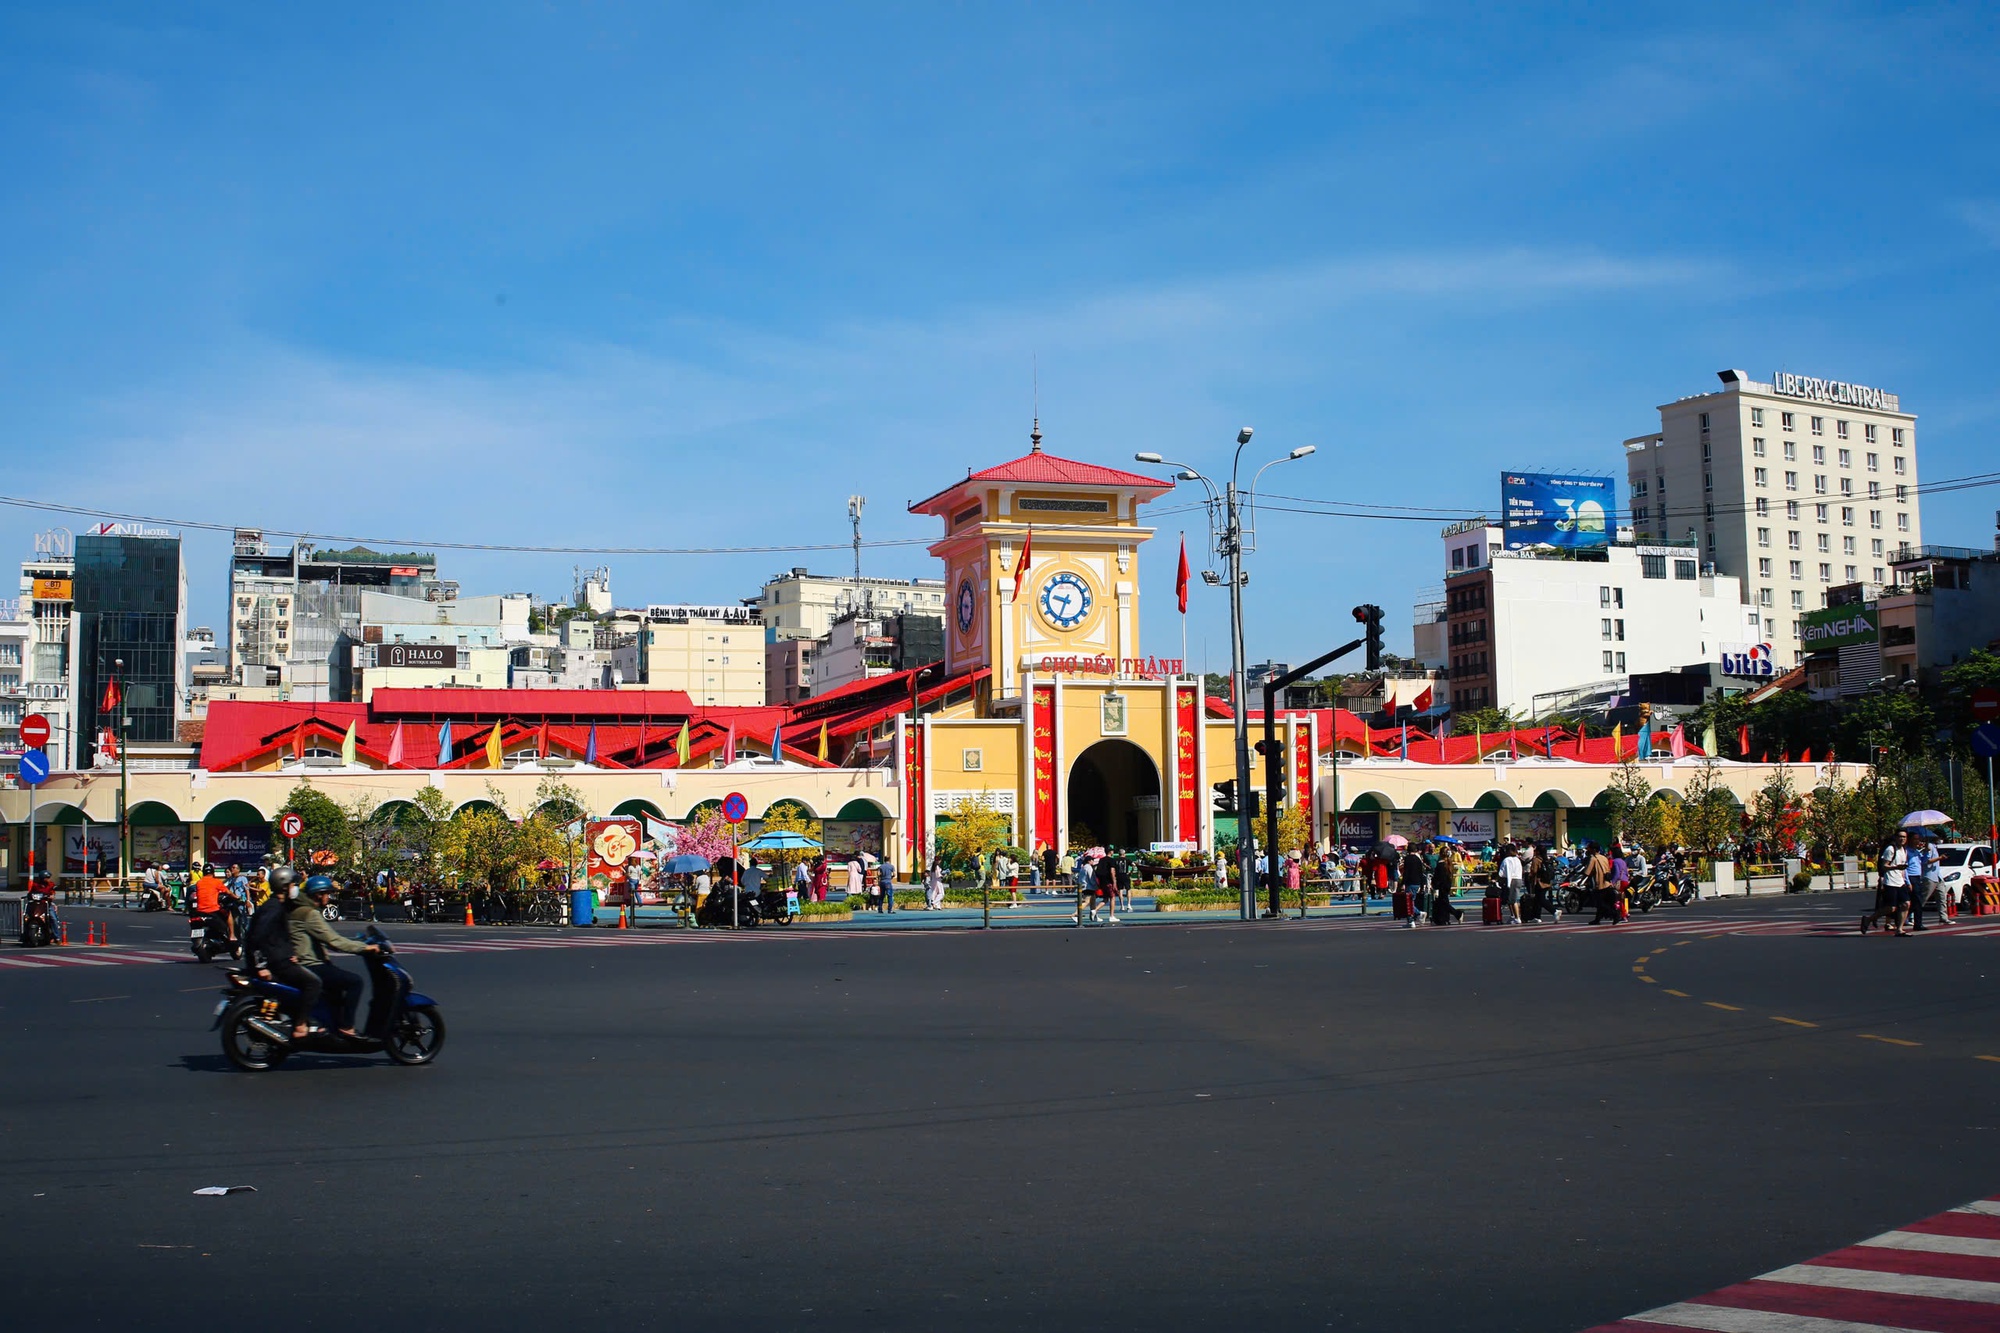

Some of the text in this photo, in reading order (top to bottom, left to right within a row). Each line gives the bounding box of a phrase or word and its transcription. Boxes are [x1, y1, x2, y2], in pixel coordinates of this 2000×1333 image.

[1774, 371, 1889, 410] LIBERTY CENTRAL
[1553, 498, 1605, 533] 30
[1490, 550, 1537, 559] OZONE BAR
[1642, 547, 1666, 556] HOTEL
[650, 607, 669, 617] BỆNH
[671, 607, 687, 617] VIỆN
[408, 649, 443, 660] HALO
[1041, 653, 1183, 675] CHỢ BẾN THÀNH
[1452, 815, 1479, 832] Vikki
[211, 829, 247, 850] Vikki
